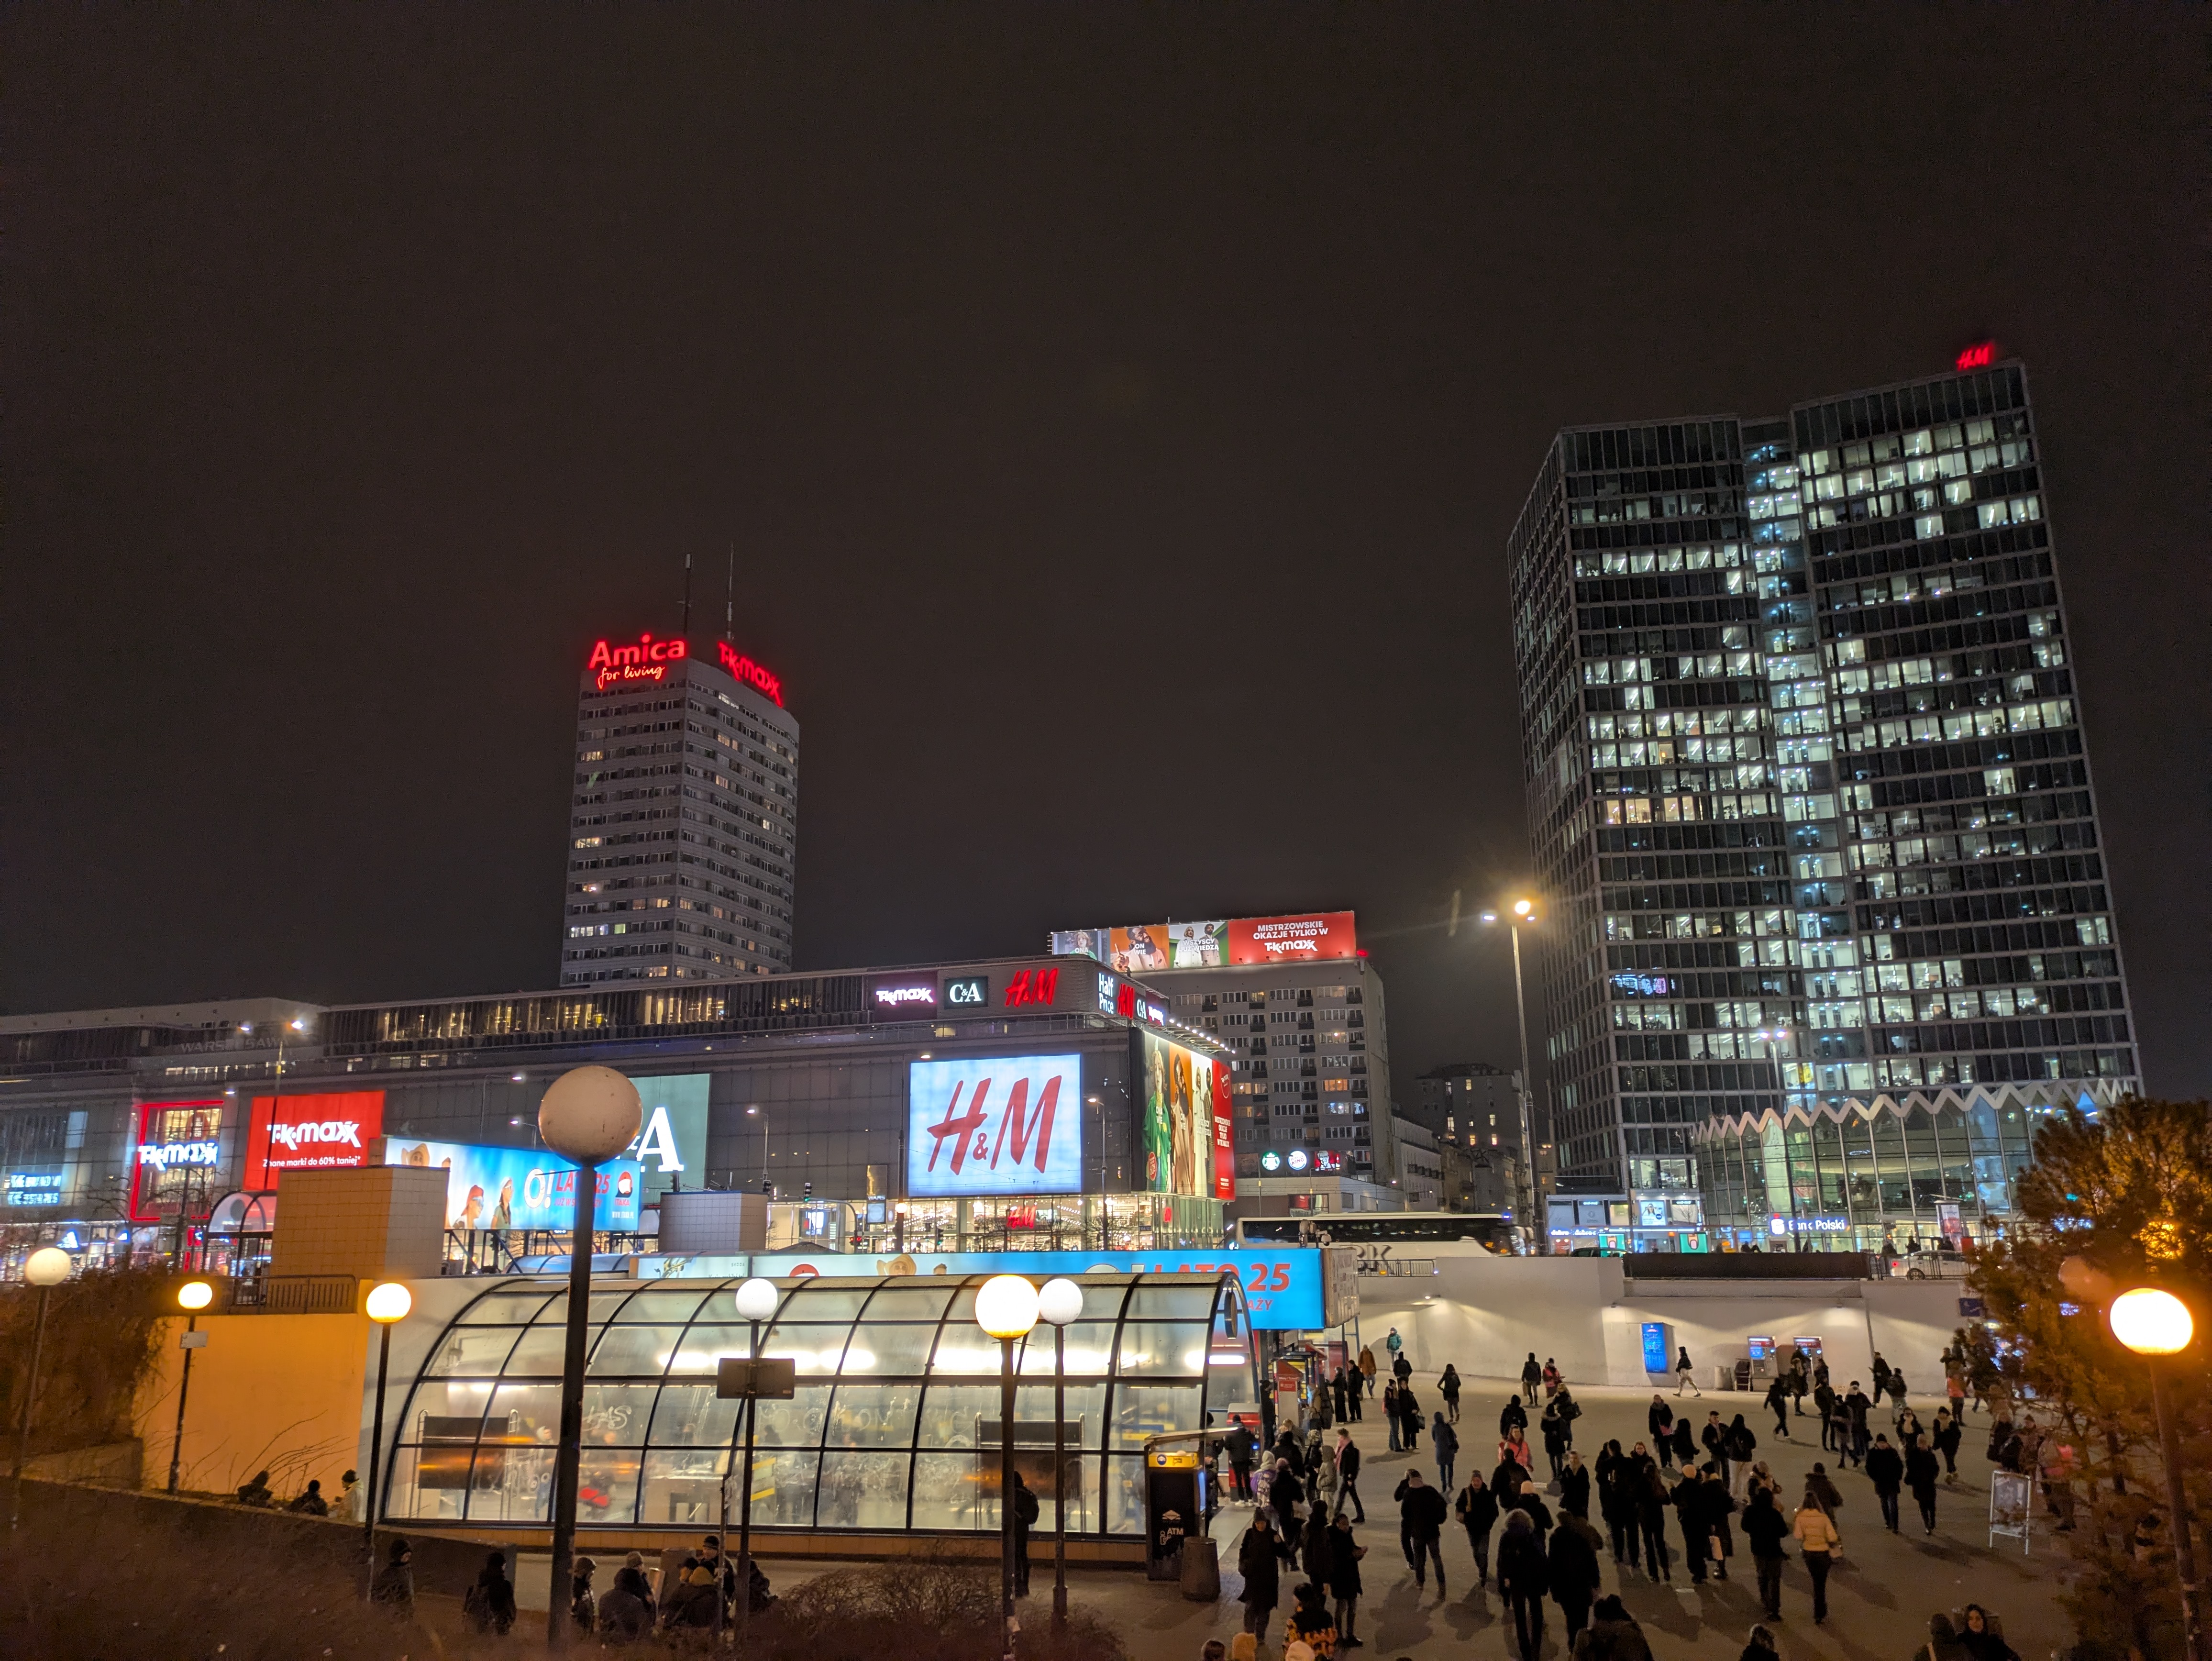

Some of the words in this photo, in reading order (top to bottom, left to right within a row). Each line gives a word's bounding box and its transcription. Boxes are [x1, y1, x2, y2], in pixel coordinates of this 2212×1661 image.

[589, 634, 685, 668] Amica
[597, 667, 620, 690] for
[624, 665, 665, 679] living
[1253, 930, 1288, 940] OKAZJE
[1289, 929, 1317, 937] TYLKO
[1257, 920, 1323, 932] MISTRZOWSKIE
[1183, 938, 1215, 946] WSZYSCY
[949, 983, 982, 1003] C&A
[1005, 967, 1059, 1007] H&M
[1098, 973, 1113, 997] Half
[1099, 993, 1114, 1014] Price
[1137, 999, 1147, 1019] C&A
[927, 1074, 1062, 1175] H&M
[287, 1158, 307, 1166] marki
[308, 1157, 317, 1166] do
[319, 1156, 335, 1165] 60%
[1291, 1158, 1305, 1166] KING
[523, 1167, 555, 1209] O!
[1815, 1219, 1845, 1230] Polski
[1246, 1263, 1291, 1292] 25
[1167, 1527, 1184, 1535] ATM
